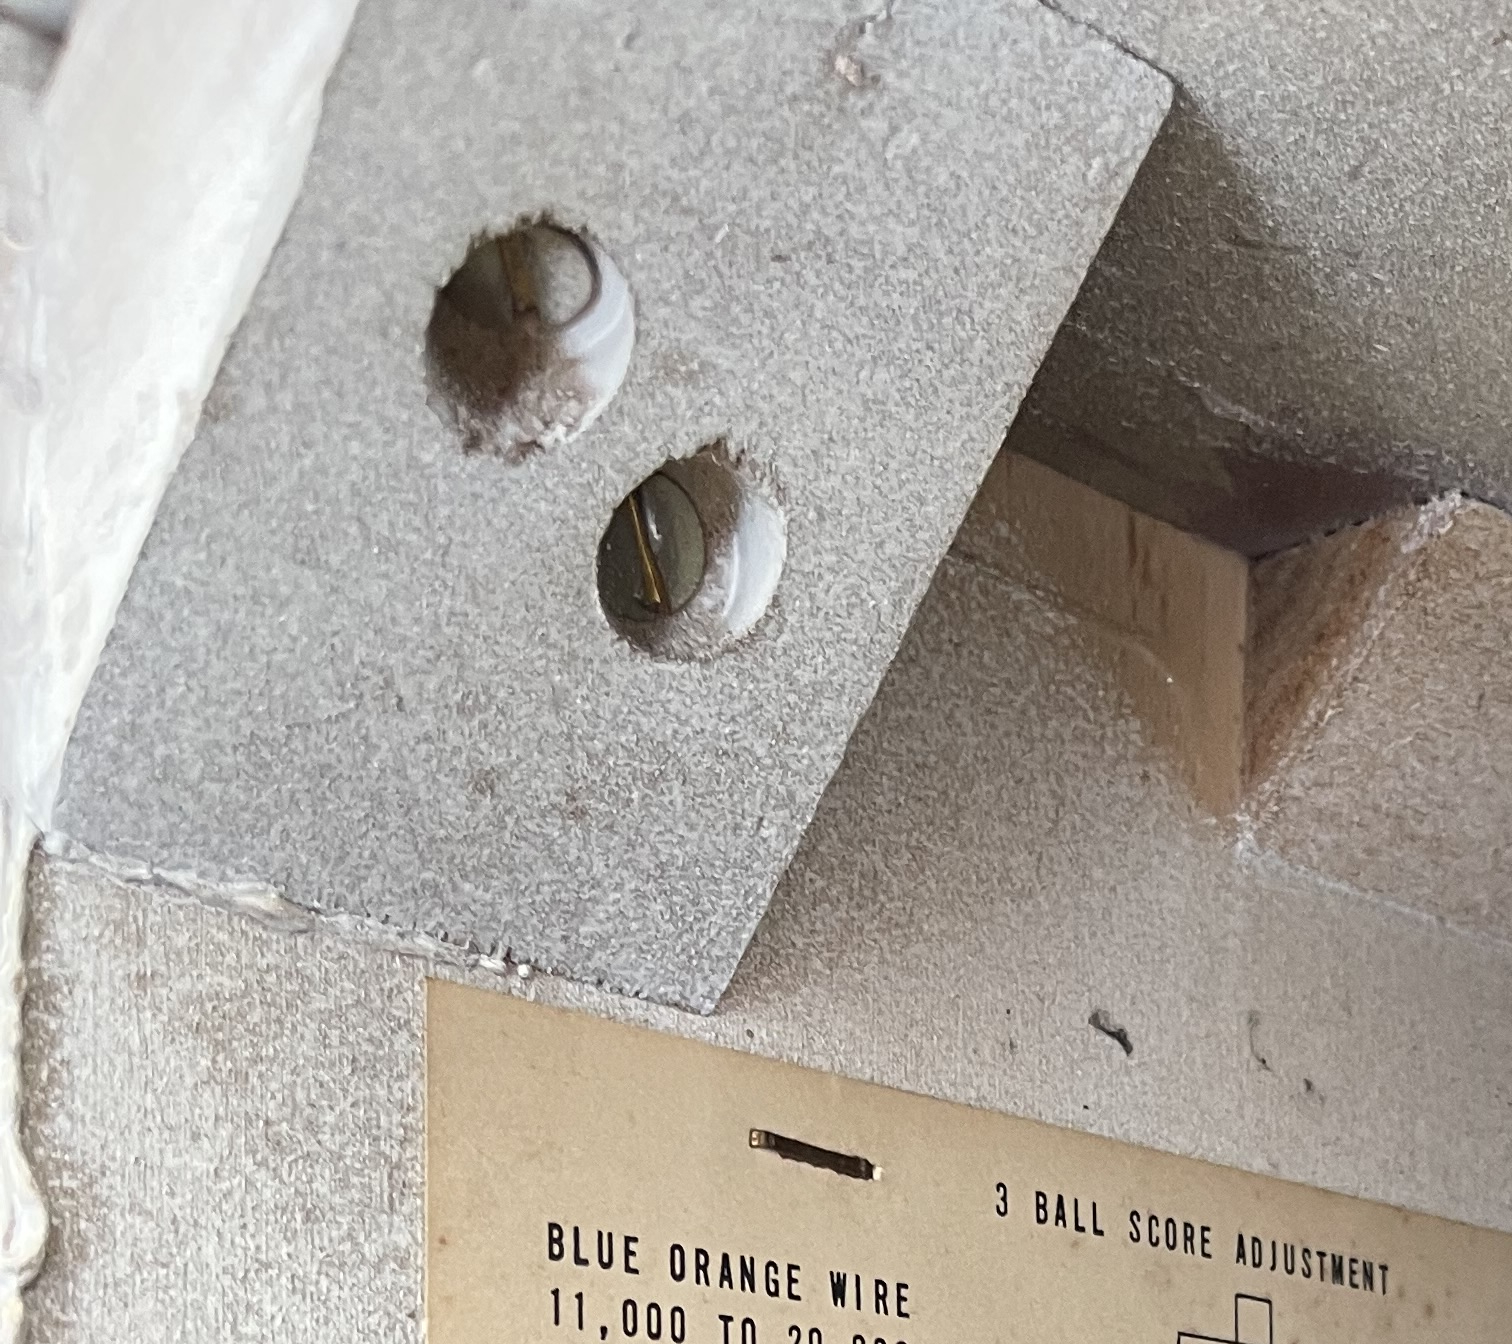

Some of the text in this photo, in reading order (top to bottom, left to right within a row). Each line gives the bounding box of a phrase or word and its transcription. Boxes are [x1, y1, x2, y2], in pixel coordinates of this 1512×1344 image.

[547, 1221, 911, 1319] BLUE ORANGE WIRE
[995, 1181, 1389, 1297] 3 BALL SCORE ADJUSTMENT
[550, 1287, 686, 1344] 11,000
